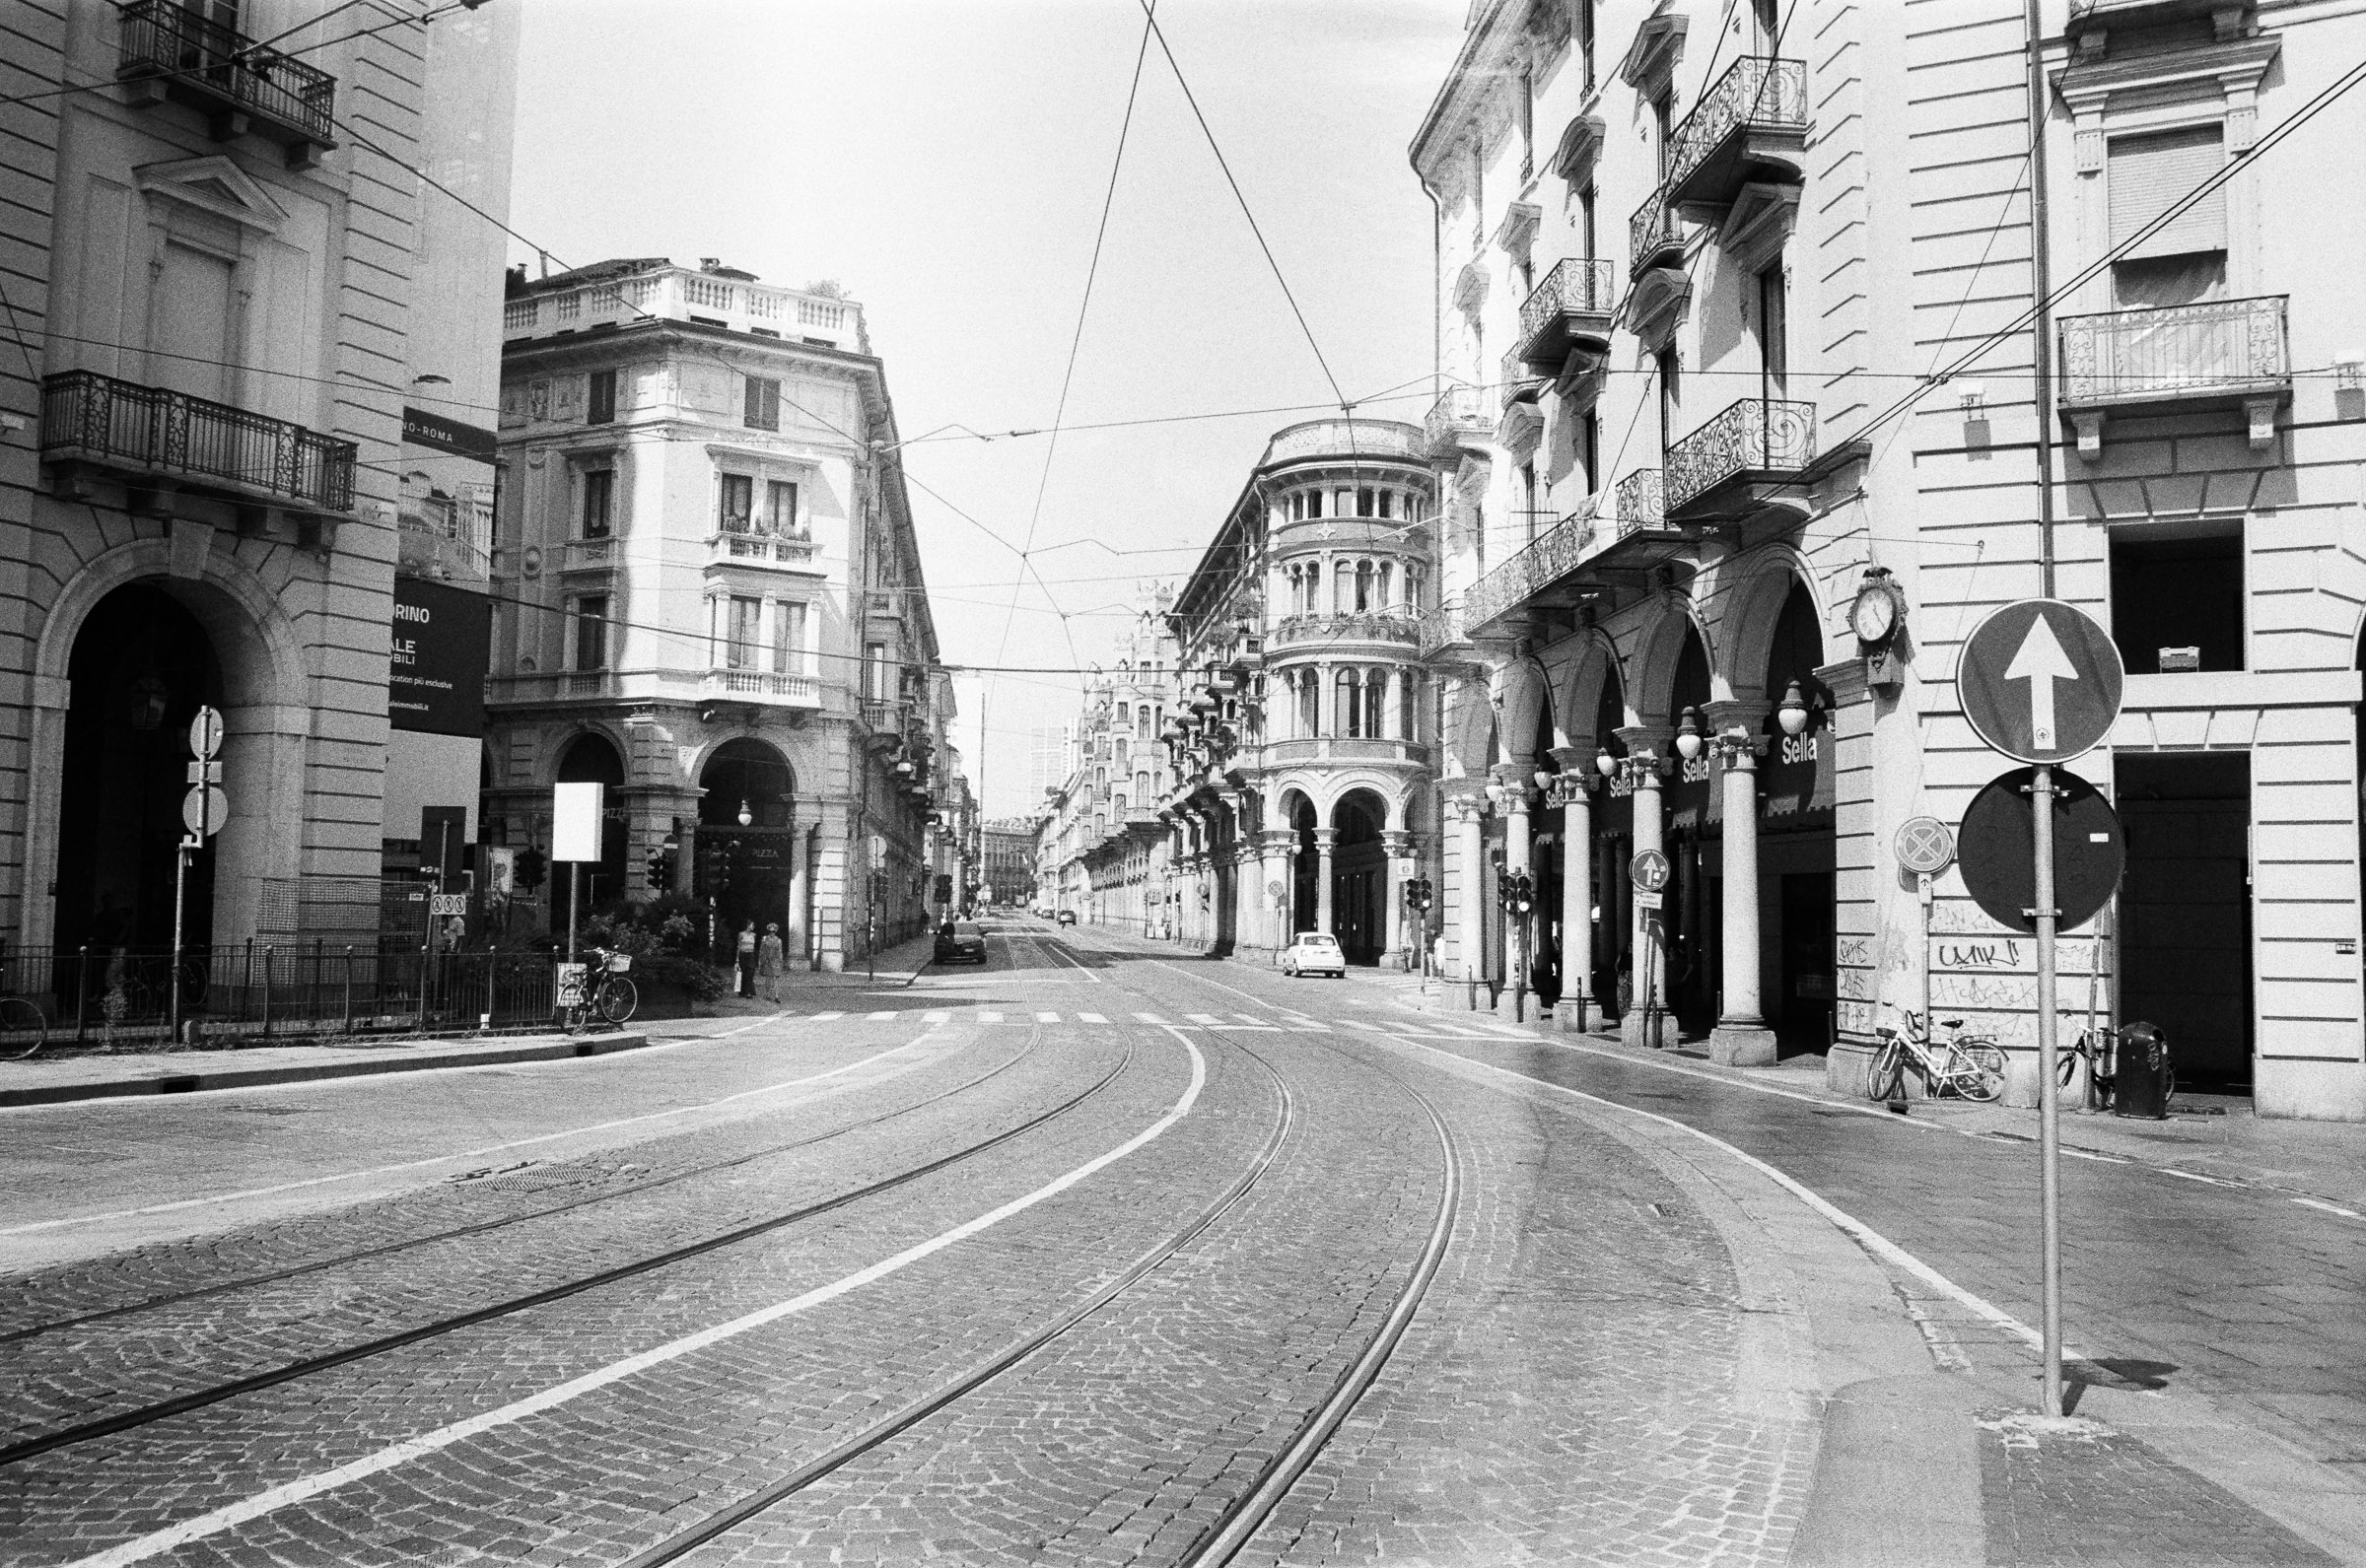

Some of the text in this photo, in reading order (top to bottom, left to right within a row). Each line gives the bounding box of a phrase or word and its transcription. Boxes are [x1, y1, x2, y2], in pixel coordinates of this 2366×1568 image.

[393, 603, 430, 624] RINO
[391, 652, 415, 664] BILI
[1781, 731, 1818, 765] Sella
[1683, 755, 1709, 784] Sella
[1610, 773, 1632, 798] Sella
[1546, 787, 1564, 810] Sella
